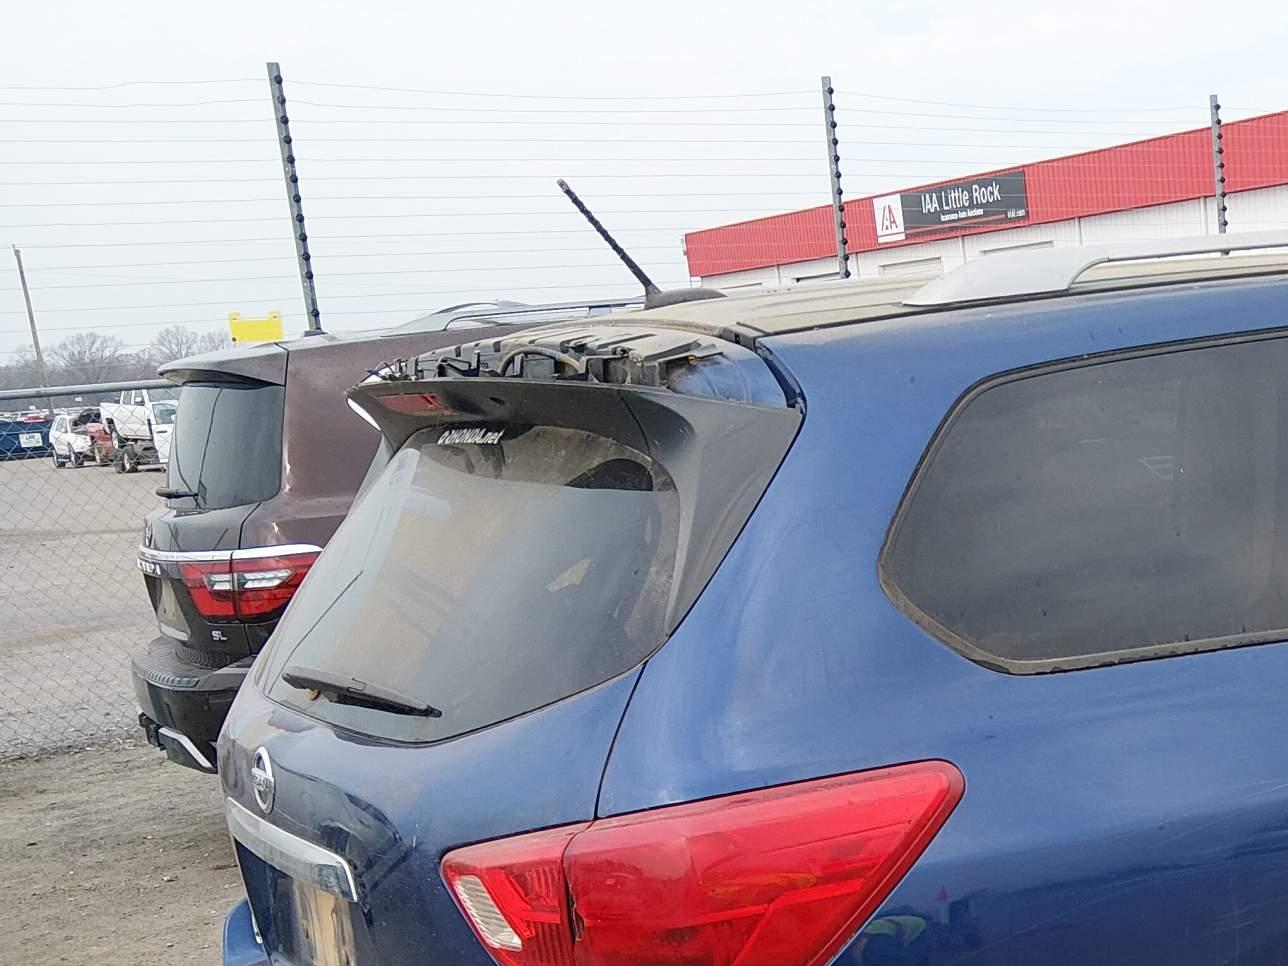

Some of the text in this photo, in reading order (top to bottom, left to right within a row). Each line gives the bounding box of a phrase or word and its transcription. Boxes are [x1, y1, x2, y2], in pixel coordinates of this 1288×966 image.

[921, 180, 1001, 214] IAA Little Rock
[211, 630, 227, 641] SL
